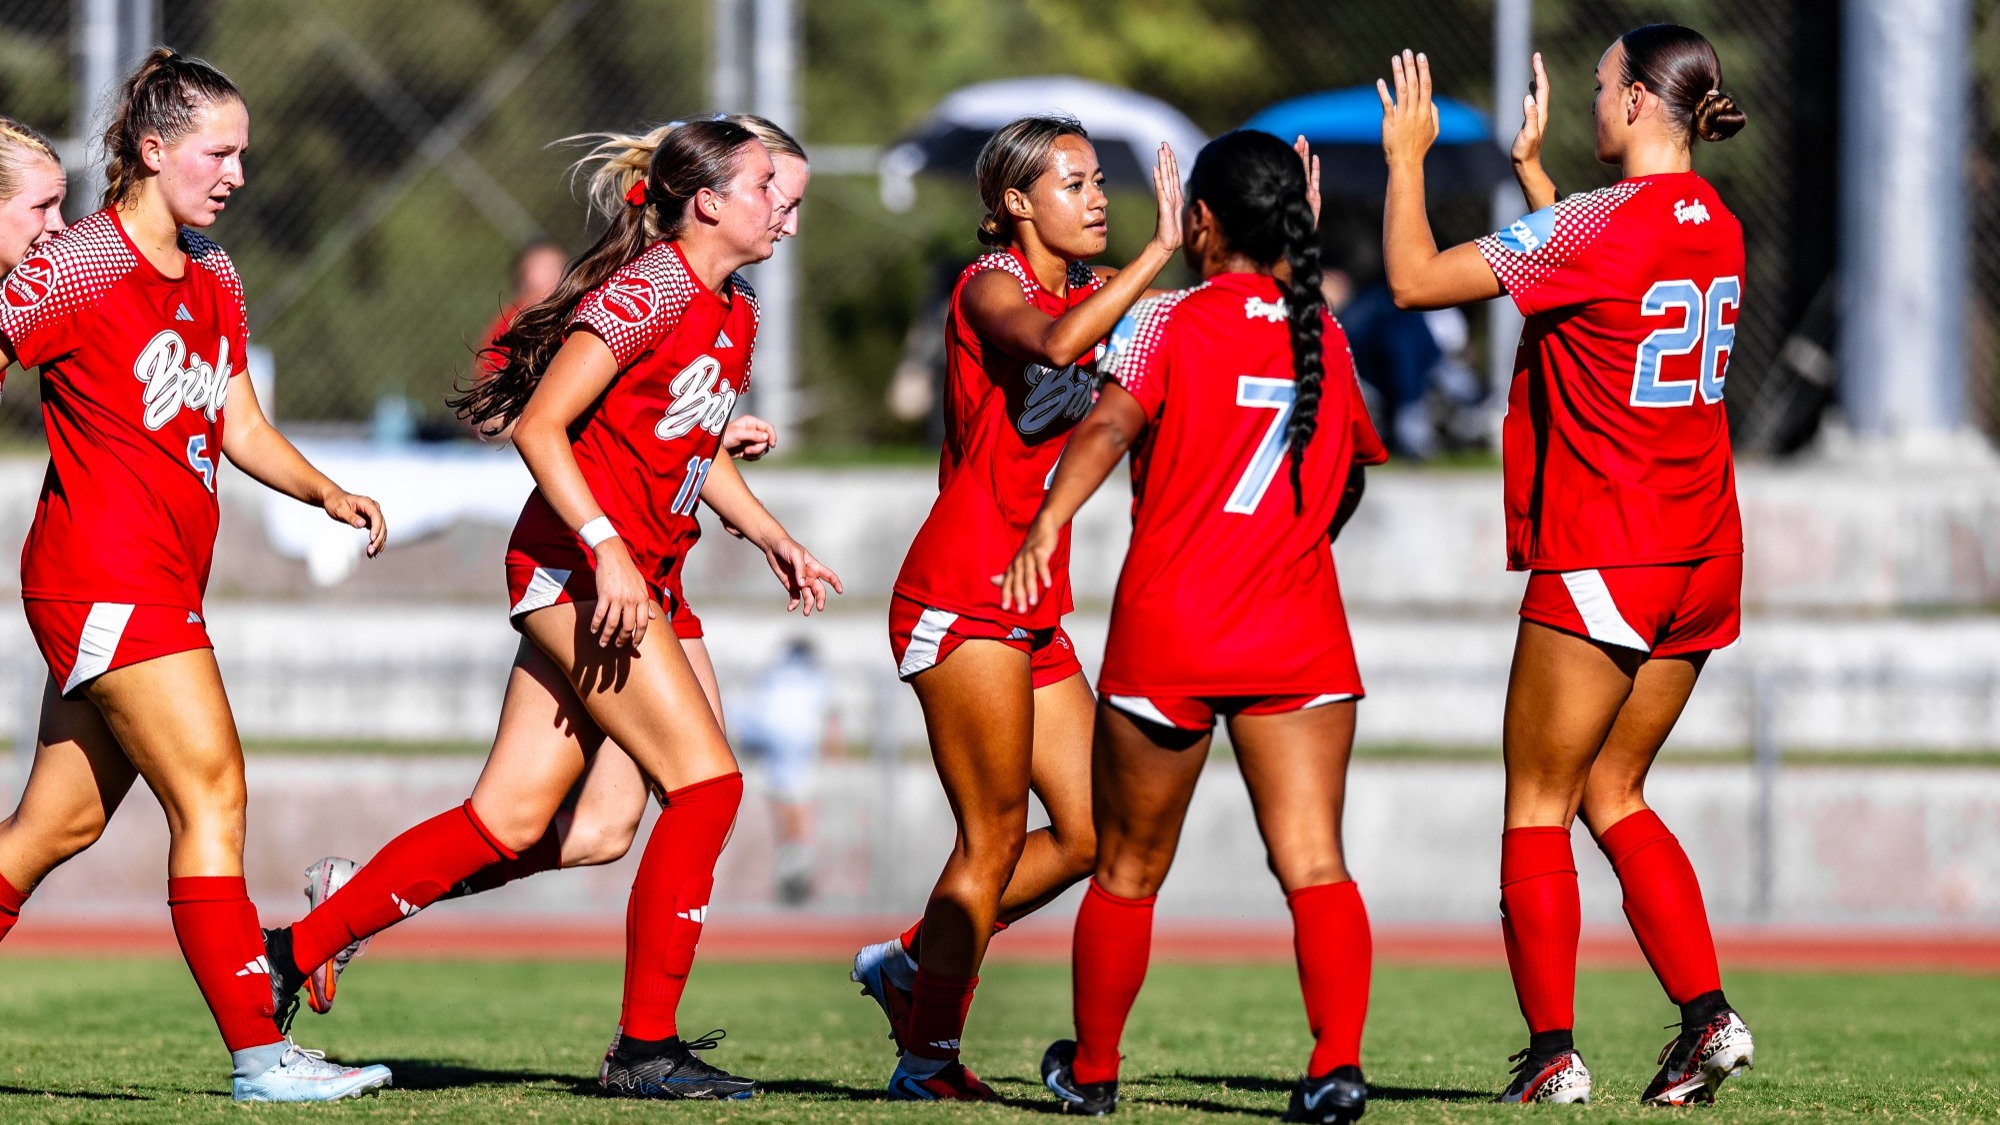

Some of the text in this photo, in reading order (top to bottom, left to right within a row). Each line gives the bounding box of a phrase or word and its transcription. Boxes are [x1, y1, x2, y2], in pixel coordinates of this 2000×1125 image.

[1509, 219, 1540, 254] CAA
[1629, 275, 1741, 408] 26
[186, 434, 215, 493] 5
[1223, 375, 1298, 515] 7
[670, 455, 713, 516] 11
